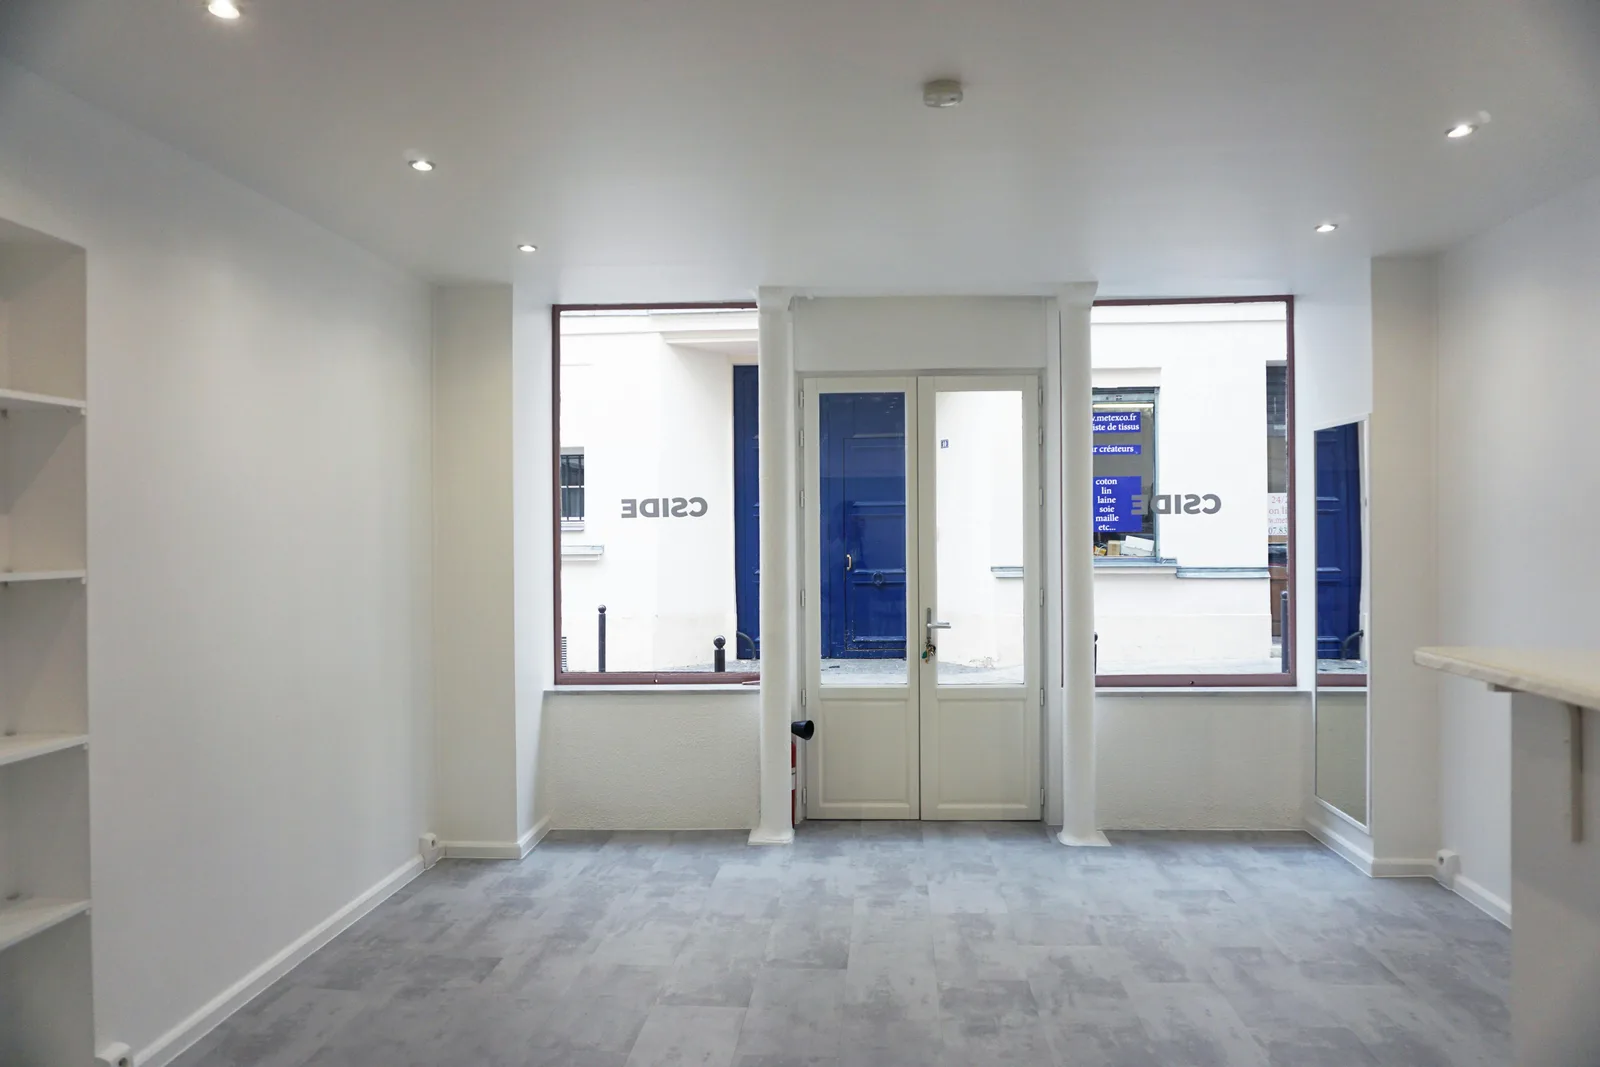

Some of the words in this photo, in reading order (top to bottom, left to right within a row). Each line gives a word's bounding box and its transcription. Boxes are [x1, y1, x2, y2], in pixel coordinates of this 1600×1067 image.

[1107, 422, 1117, 431] de
[1118, 423, 1140, 431] tissus
[1099, 444, 1134, 453] créateurs
[1101, 486, 1112, 495] lin
[1097, 495, 1117, 504] laine
[1099, 505, 1115, 513] soie
[1095, 513, 1120, 522] maille
